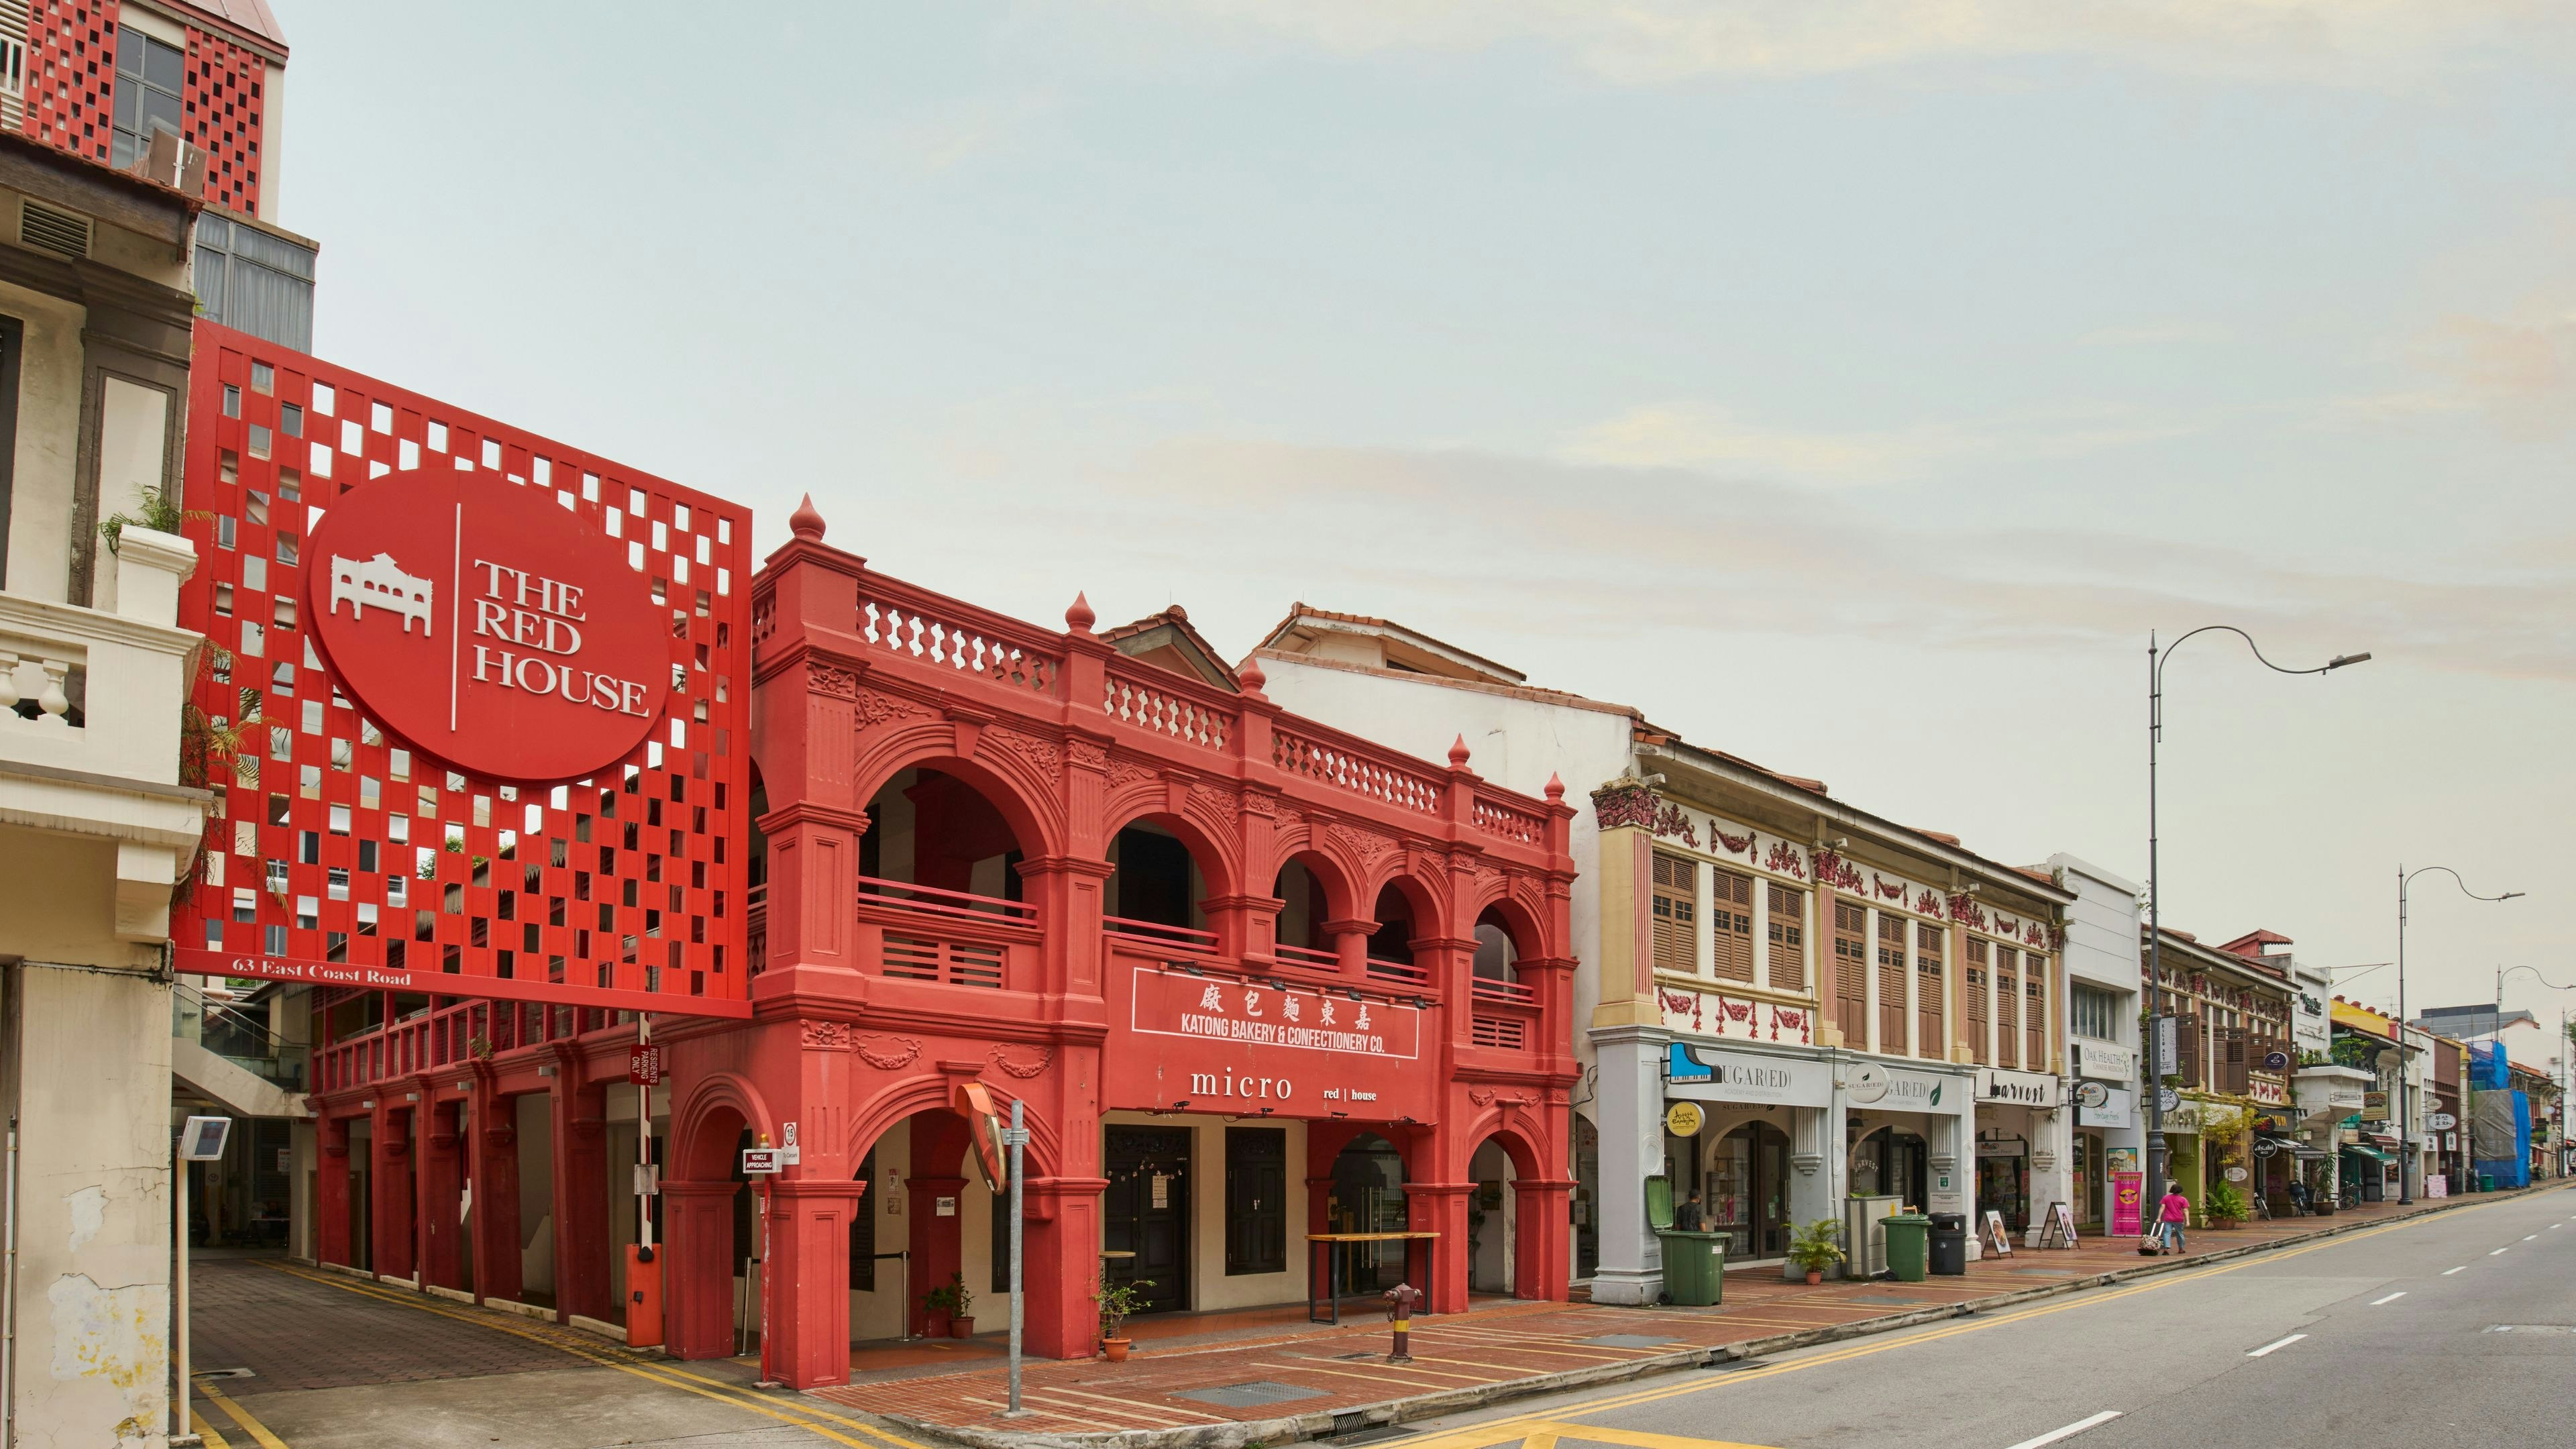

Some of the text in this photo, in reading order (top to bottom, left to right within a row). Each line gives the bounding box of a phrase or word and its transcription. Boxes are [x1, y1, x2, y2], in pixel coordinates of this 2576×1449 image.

[474, 559, 586, 622] THE
[474, 598, 581, 655] RED
[472, 645, 649, 717] HOUSE
[233, 959, 411, 985] 63 East Coast Road
[1181, 1013, 1385, 1053] KATONG BAKERY & CONFECTIONERY CO.
[632, 1057, 640, 1073] ONLY
[641, 1051, 649, 1079] PARKING
[1717, 1064, 1791, 1089] UGAR(ED)
[1191, 1067, 1291, 1099] micro
[1324, 1088, 1339, 1099] red
[1351, 1089, 1376, 1101] house
[1887, 1080, 1929, 1099] GAR(ED)
[787, 1129, 793, 1137] 15
[2273, 1115, 2286, 1126] KUYA
